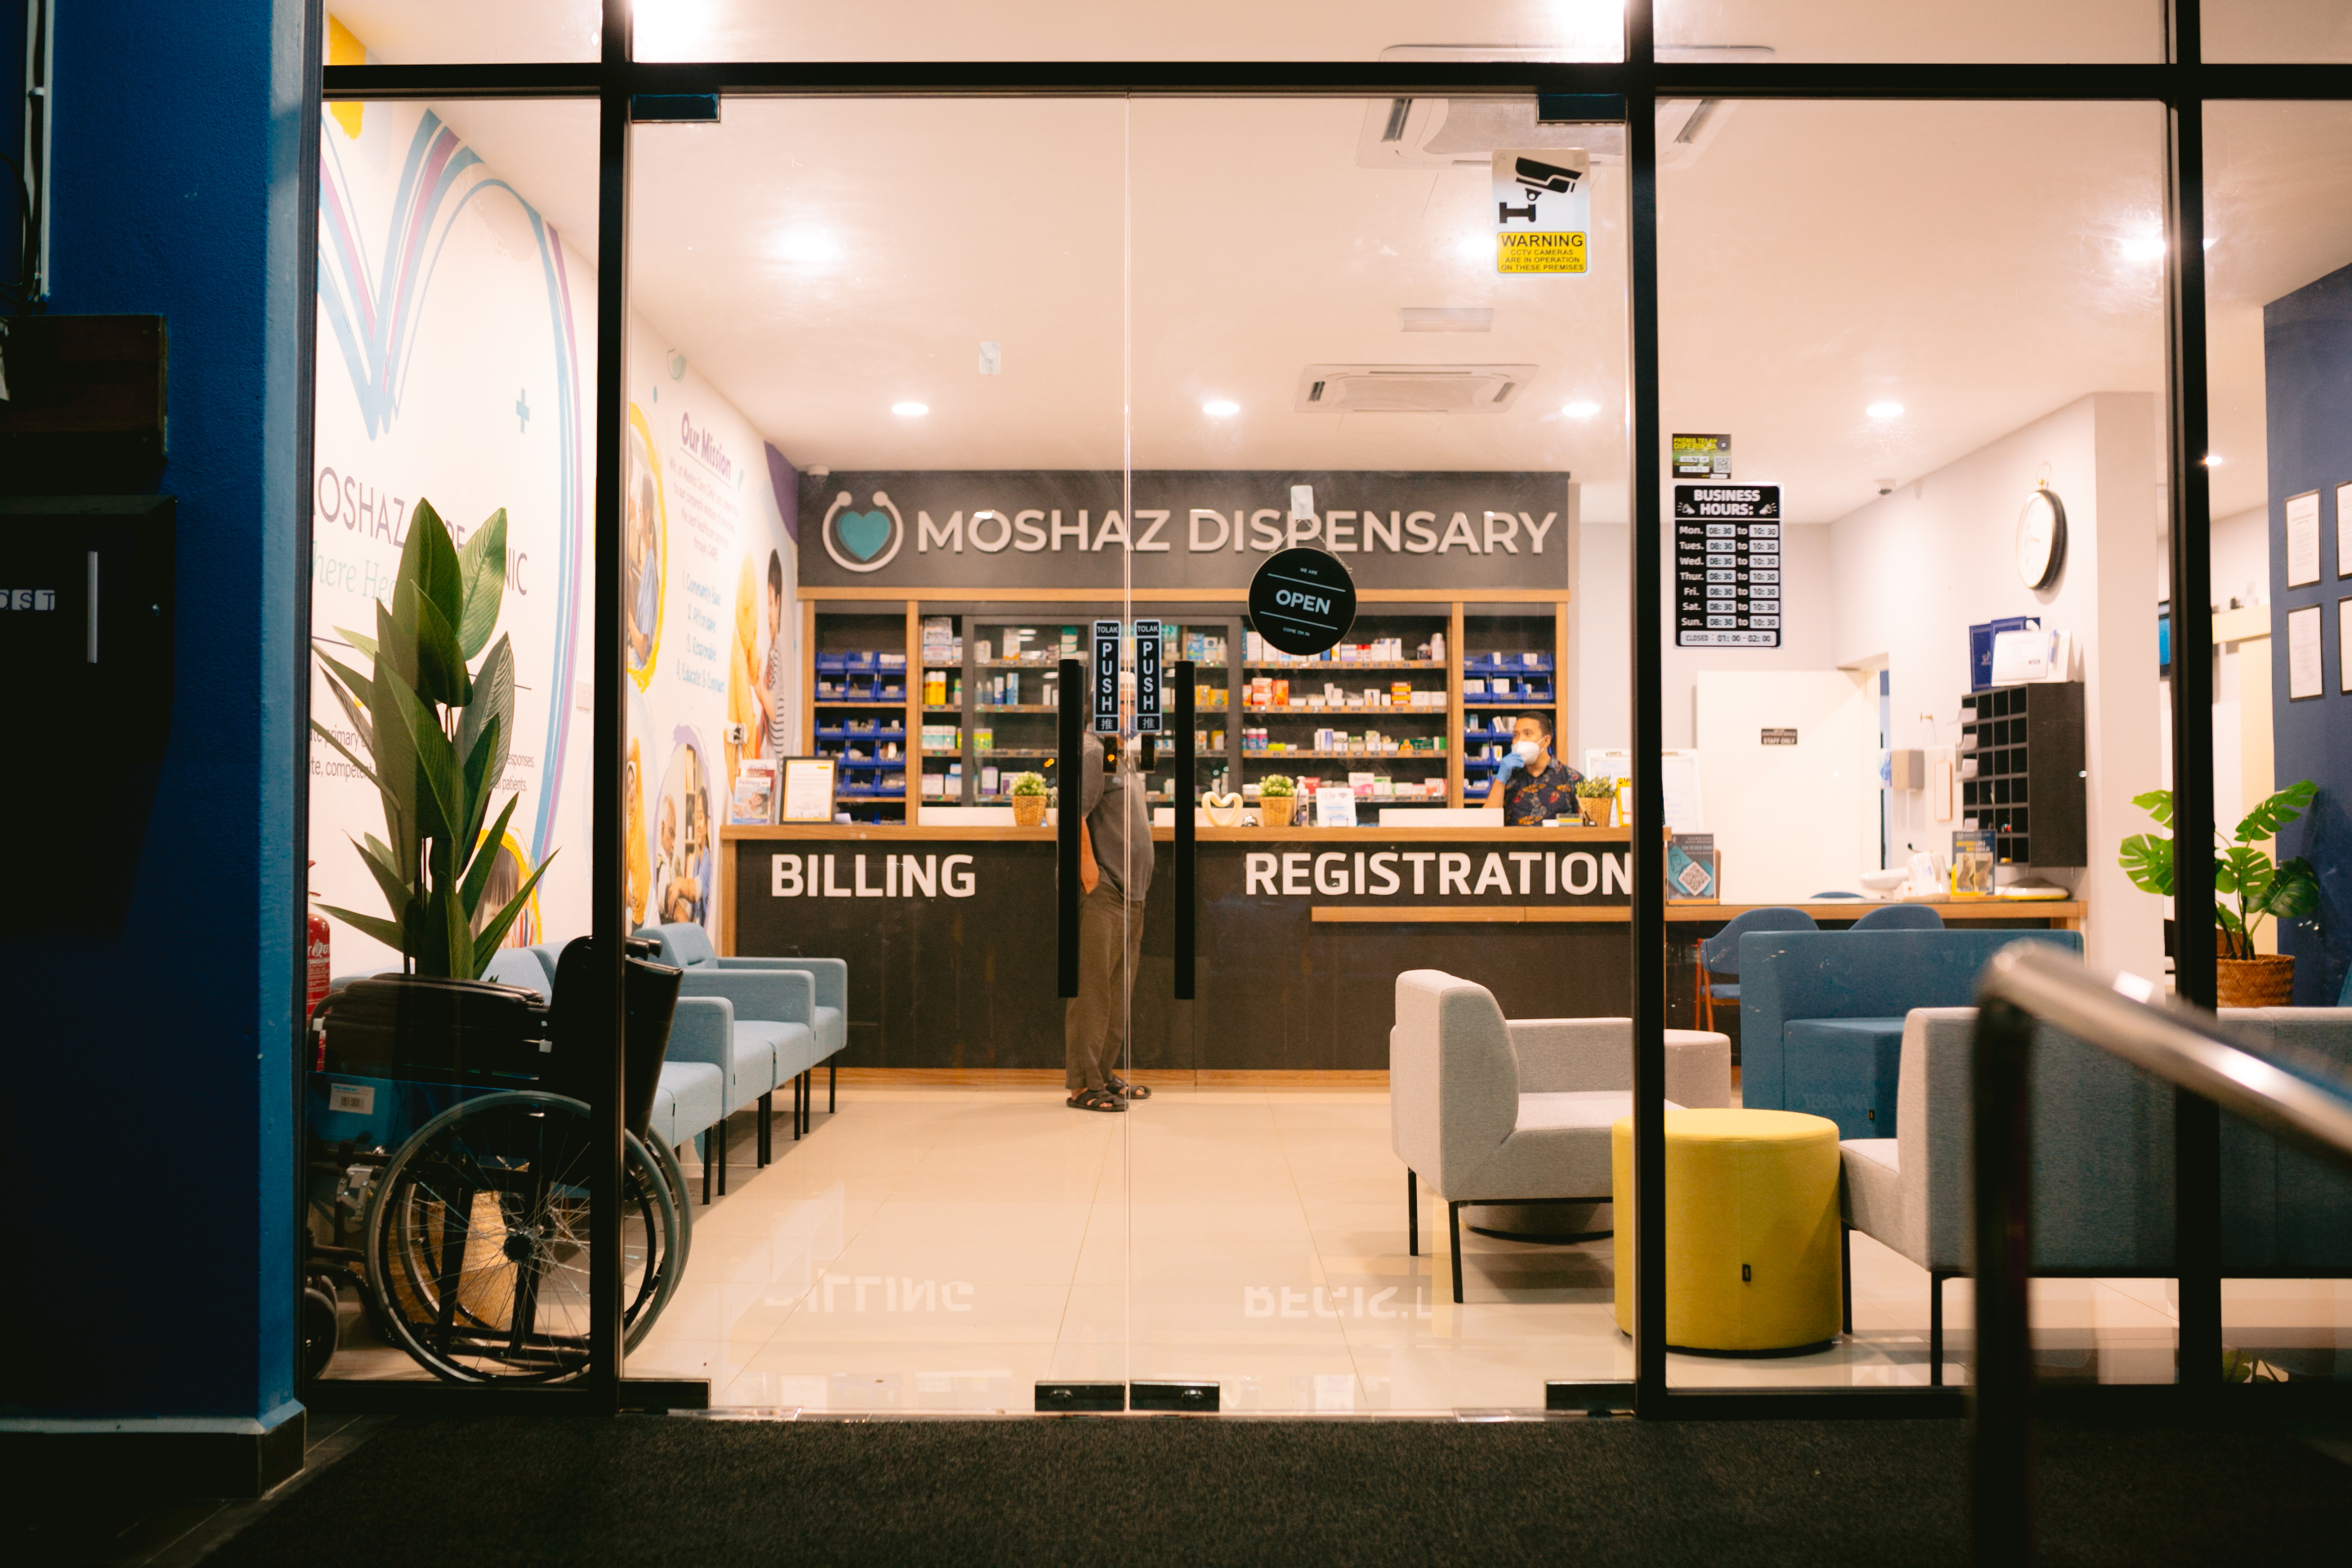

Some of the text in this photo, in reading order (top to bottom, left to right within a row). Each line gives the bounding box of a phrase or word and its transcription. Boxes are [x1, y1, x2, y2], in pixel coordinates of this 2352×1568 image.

[1501, 234, 1583, 247] WARNING
[681, 412, 732, 481] Our Mission
[1694, 489, 1761, 501] BUSINESS
[314, 466, 406, 549] OSHAZ
[1699, 503, 1754, 515] HOURS:
[917, 508, 1557, 554] MOSHAZ DISPENSARY
[1679, 526, 1704, 534] Mon.
[1679, 541, 1704, 550] Tues.
[1737, 542, 1748, 550] to
[1679, 557, 1704, 565] Wed.
[1679, 572, 1704, 580] Thur.
[1683, 587, 1699, 595] Fri.
[1276, 589, 1331, 615] OPEN
[1682, 602, 1701, 611] Sat.
[1681, 617, 1703, 626] Sun.
[1097, 626, 1119, 634] TOLAK
[1137, 625, 1159, 633] TOLAK
[1102, 642, 1112, 712] PUSH
[1143, 641, 1154, 710] PUSH
[1101, 718, 1113, 730] 推
[1143, 717, 1155, 729] 推
[506, 754, 535, 769] esponses,
[502, 775, 528, 795] patients.
[772, 854, 975, 898] BILLING
[1245, 852, 1632, 895] REGISTRATION
